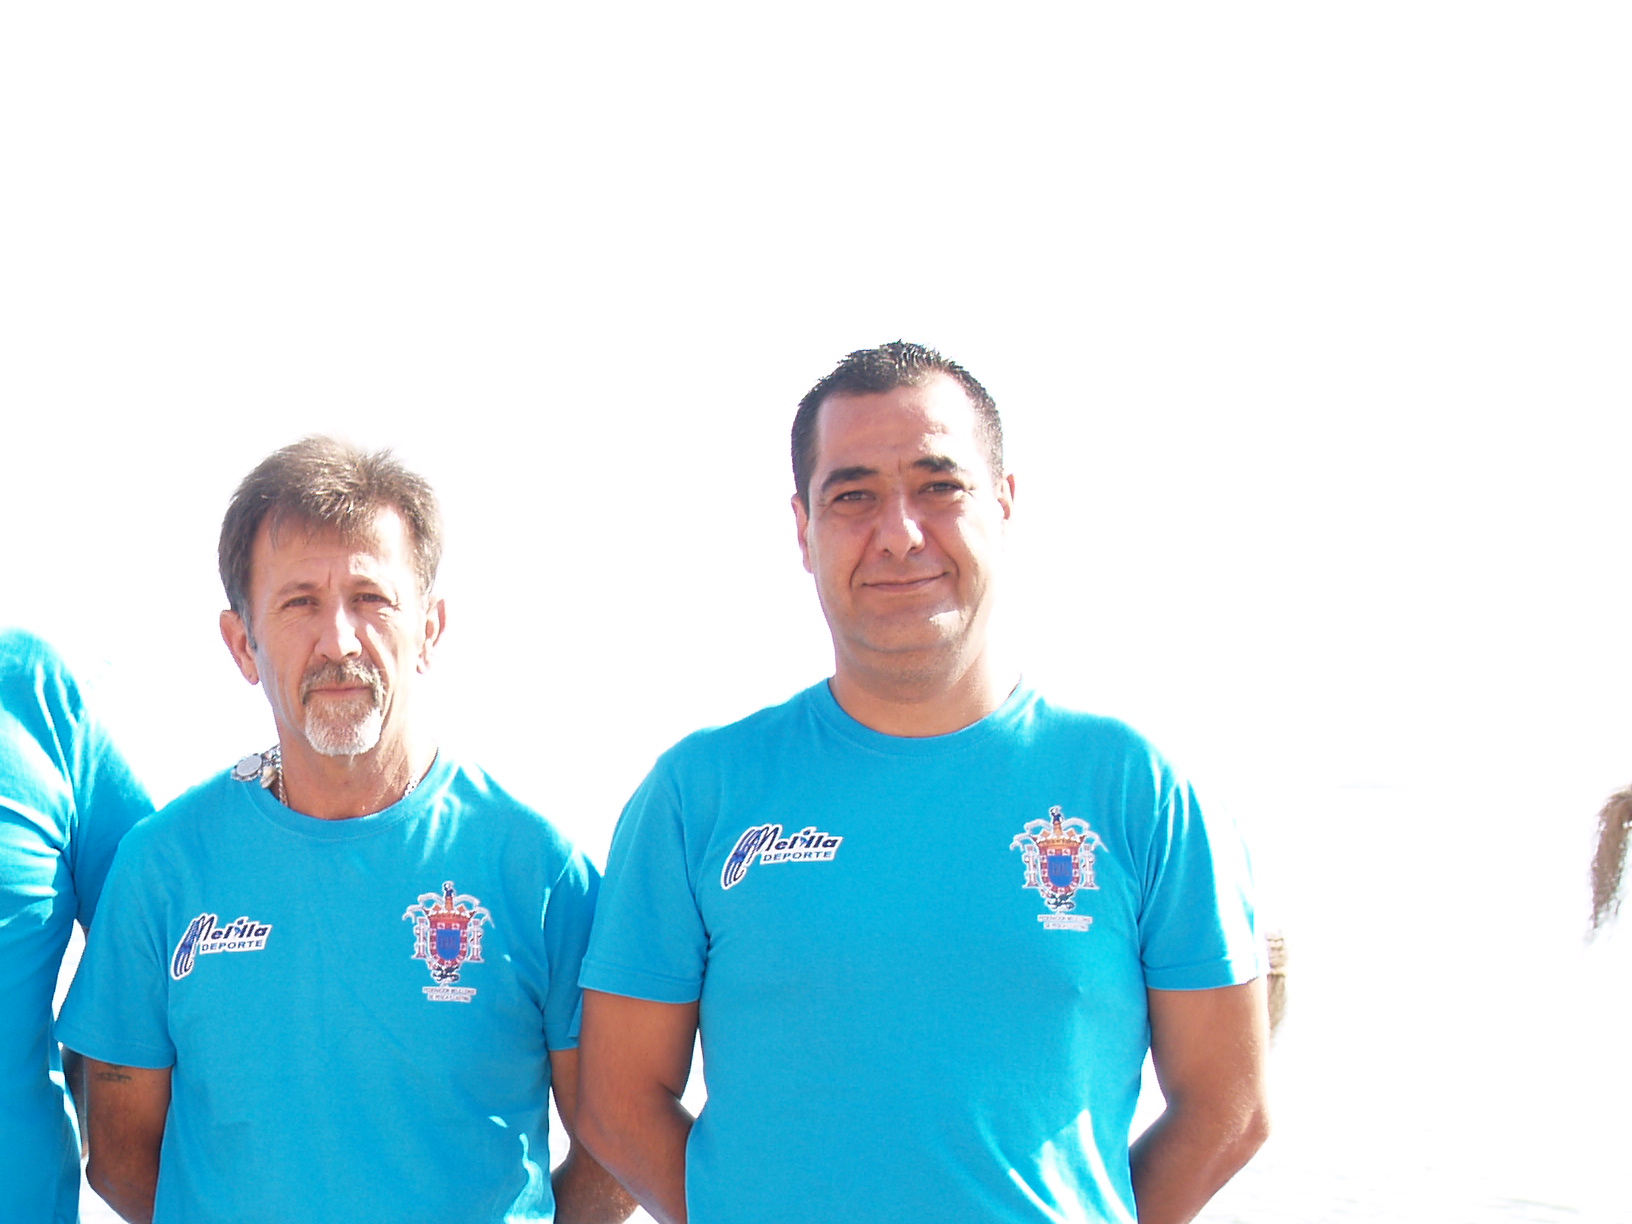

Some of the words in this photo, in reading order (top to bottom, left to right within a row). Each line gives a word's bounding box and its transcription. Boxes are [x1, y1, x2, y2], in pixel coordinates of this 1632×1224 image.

[722, 826, 840, 888] Melilla
[763, 850, 831, 862] DEPORTE
[172, 915, 269, 978] Melilla
[200, 939, 264, 951] DEPORTE
